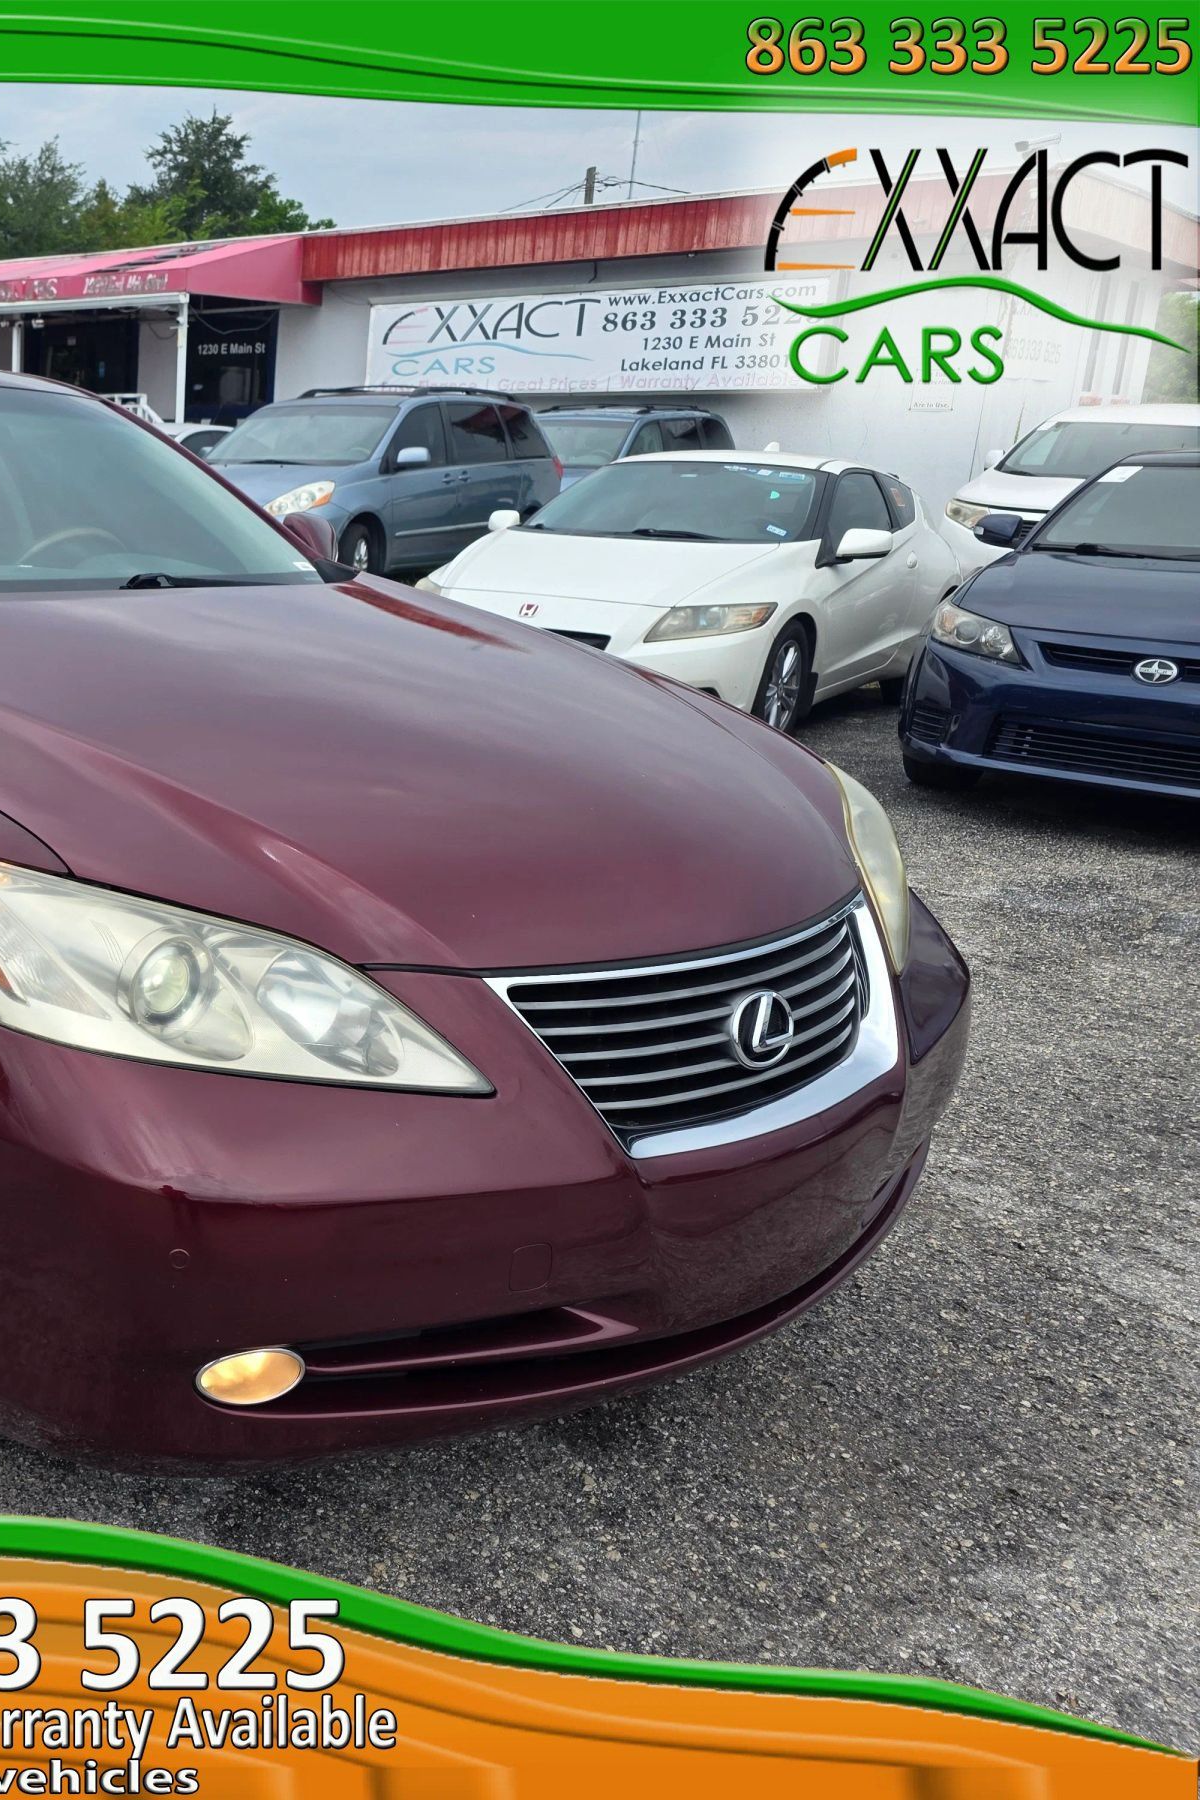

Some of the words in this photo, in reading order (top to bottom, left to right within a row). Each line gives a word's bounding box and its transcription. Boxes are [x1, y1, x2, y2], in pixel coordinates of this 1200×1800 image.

[608, 285, 817, 307] www.ExxactCars.com
[382, 298, 601, 346] EXXACT
[602, 310, 656, 333] 863
[669, 307, 728, 330] 333
[198, 343, 218, 355] 1230
[221, 343, 228, 355] E
[230, 342, 252, 354] Main
[255, 342, 266, 354] St
[642, 335, 683, 351] 1230
[689, 336, 699, 349] E
[704, 333, 751, 350] Main
[759, 333, 777, 347] St
[391, 356, 496, 378] CARS
[621, 356, 705, 372] Lakeland
[711, 356, 728, 370] FL
[734, 354, 788, 370] 33801
[499, 376, 544, 392] Great
[620, 374, 701, 391] Warranty
